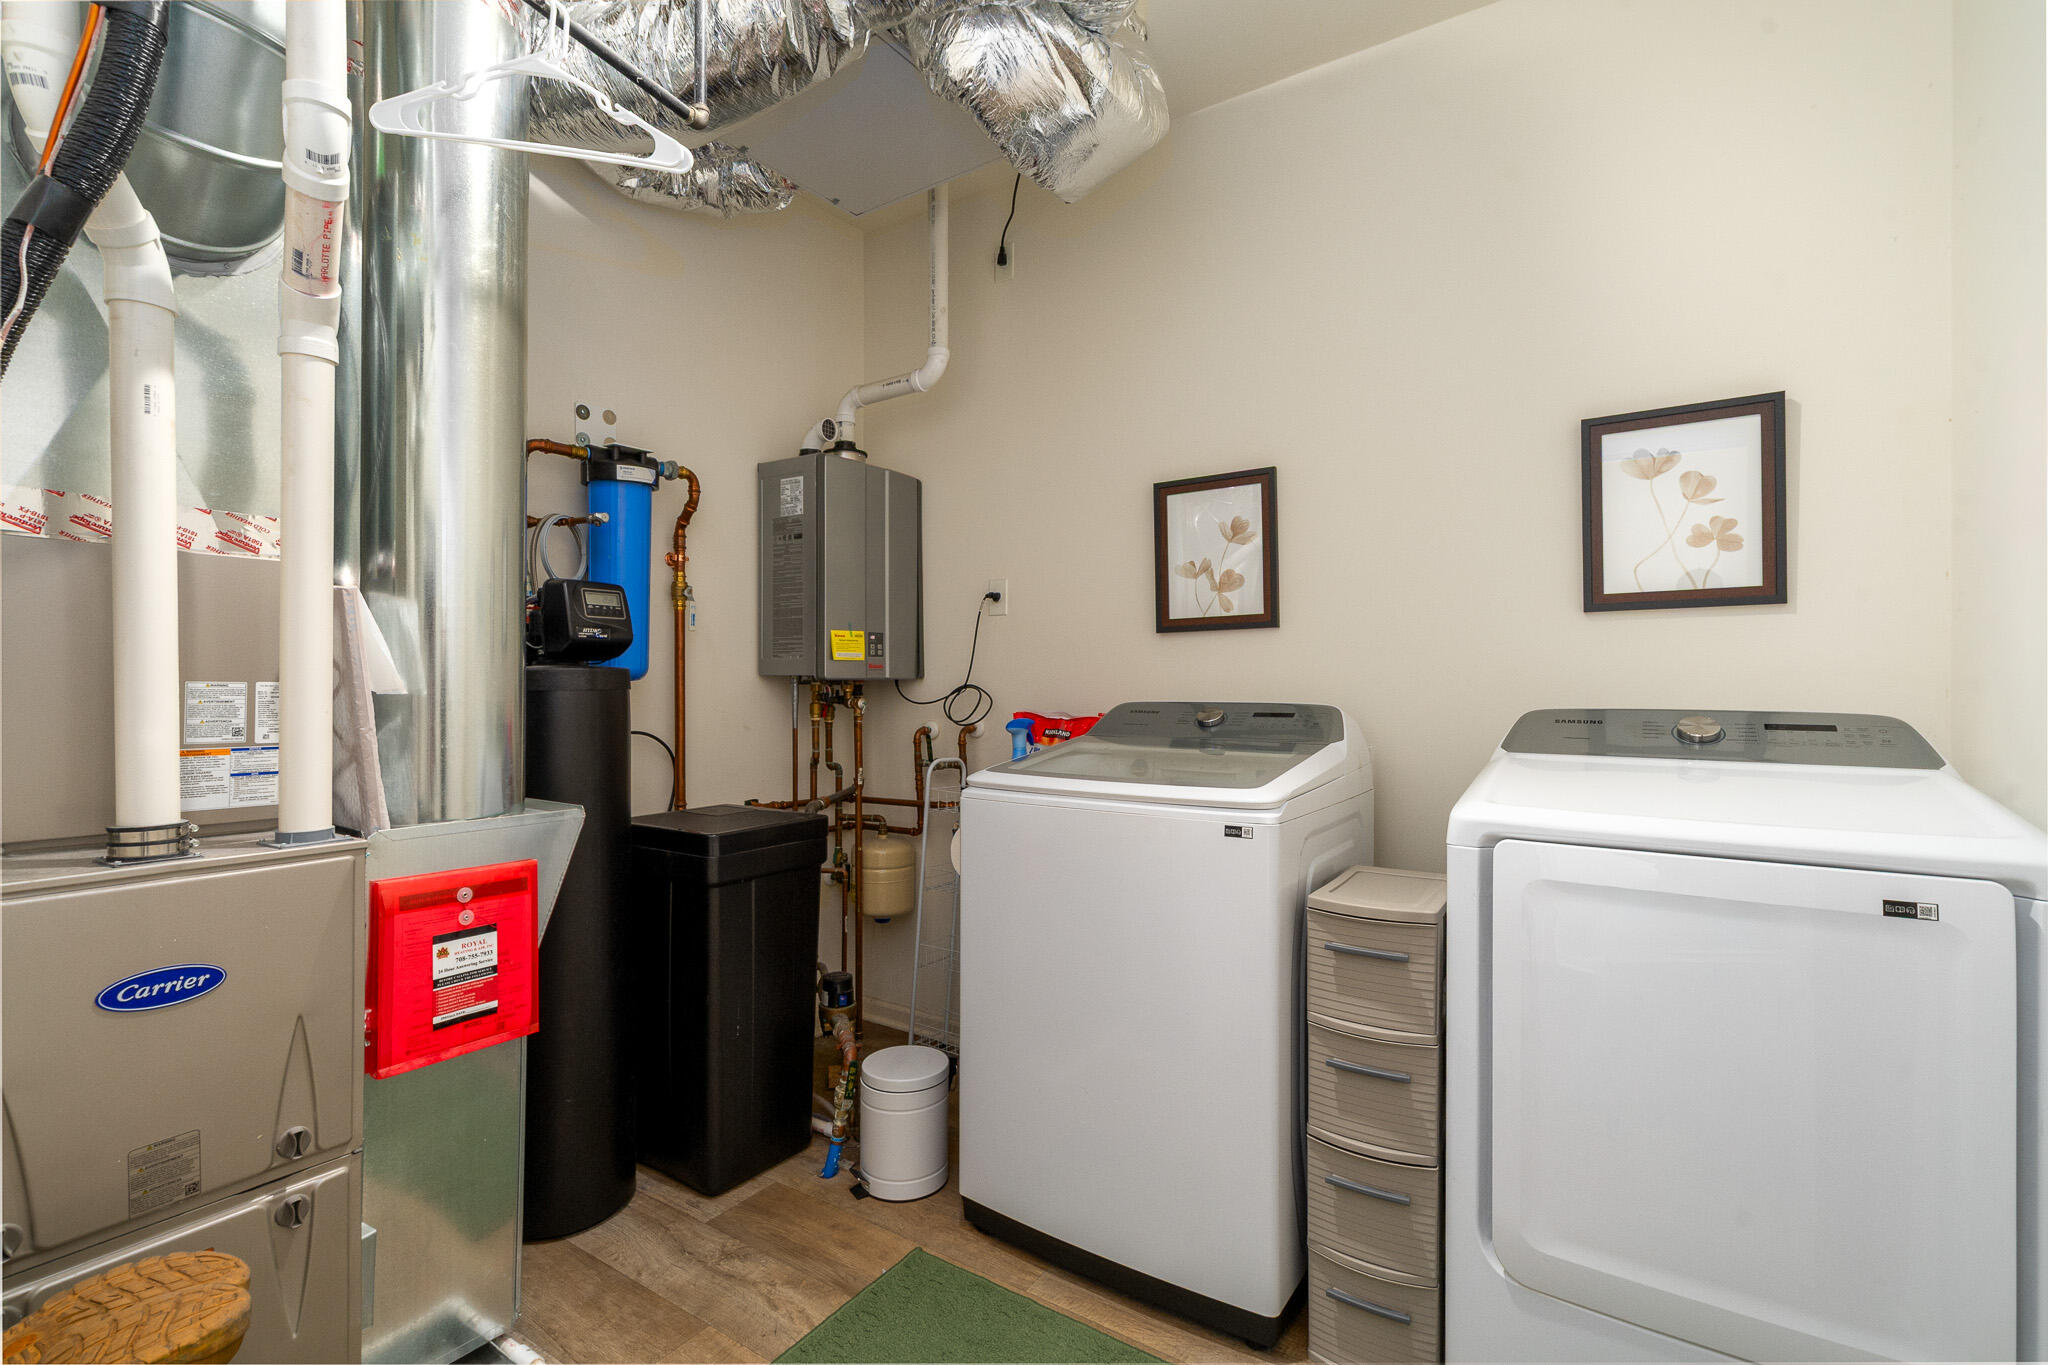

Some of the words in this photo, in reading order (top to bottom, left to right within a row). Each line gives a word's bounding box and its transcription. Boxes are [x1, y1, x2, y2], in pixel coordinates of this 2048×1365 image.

[323, 218, 333, 240] PIPE
[321, 243, 331, 284] HARLOTTE
[1045, 728, 1071, 737] KIRKLAND
[461, 938, 487, 949] ROYAL
[456, 962, 478, 970] Answering
[116, 973, 211, 1003] Carrier
